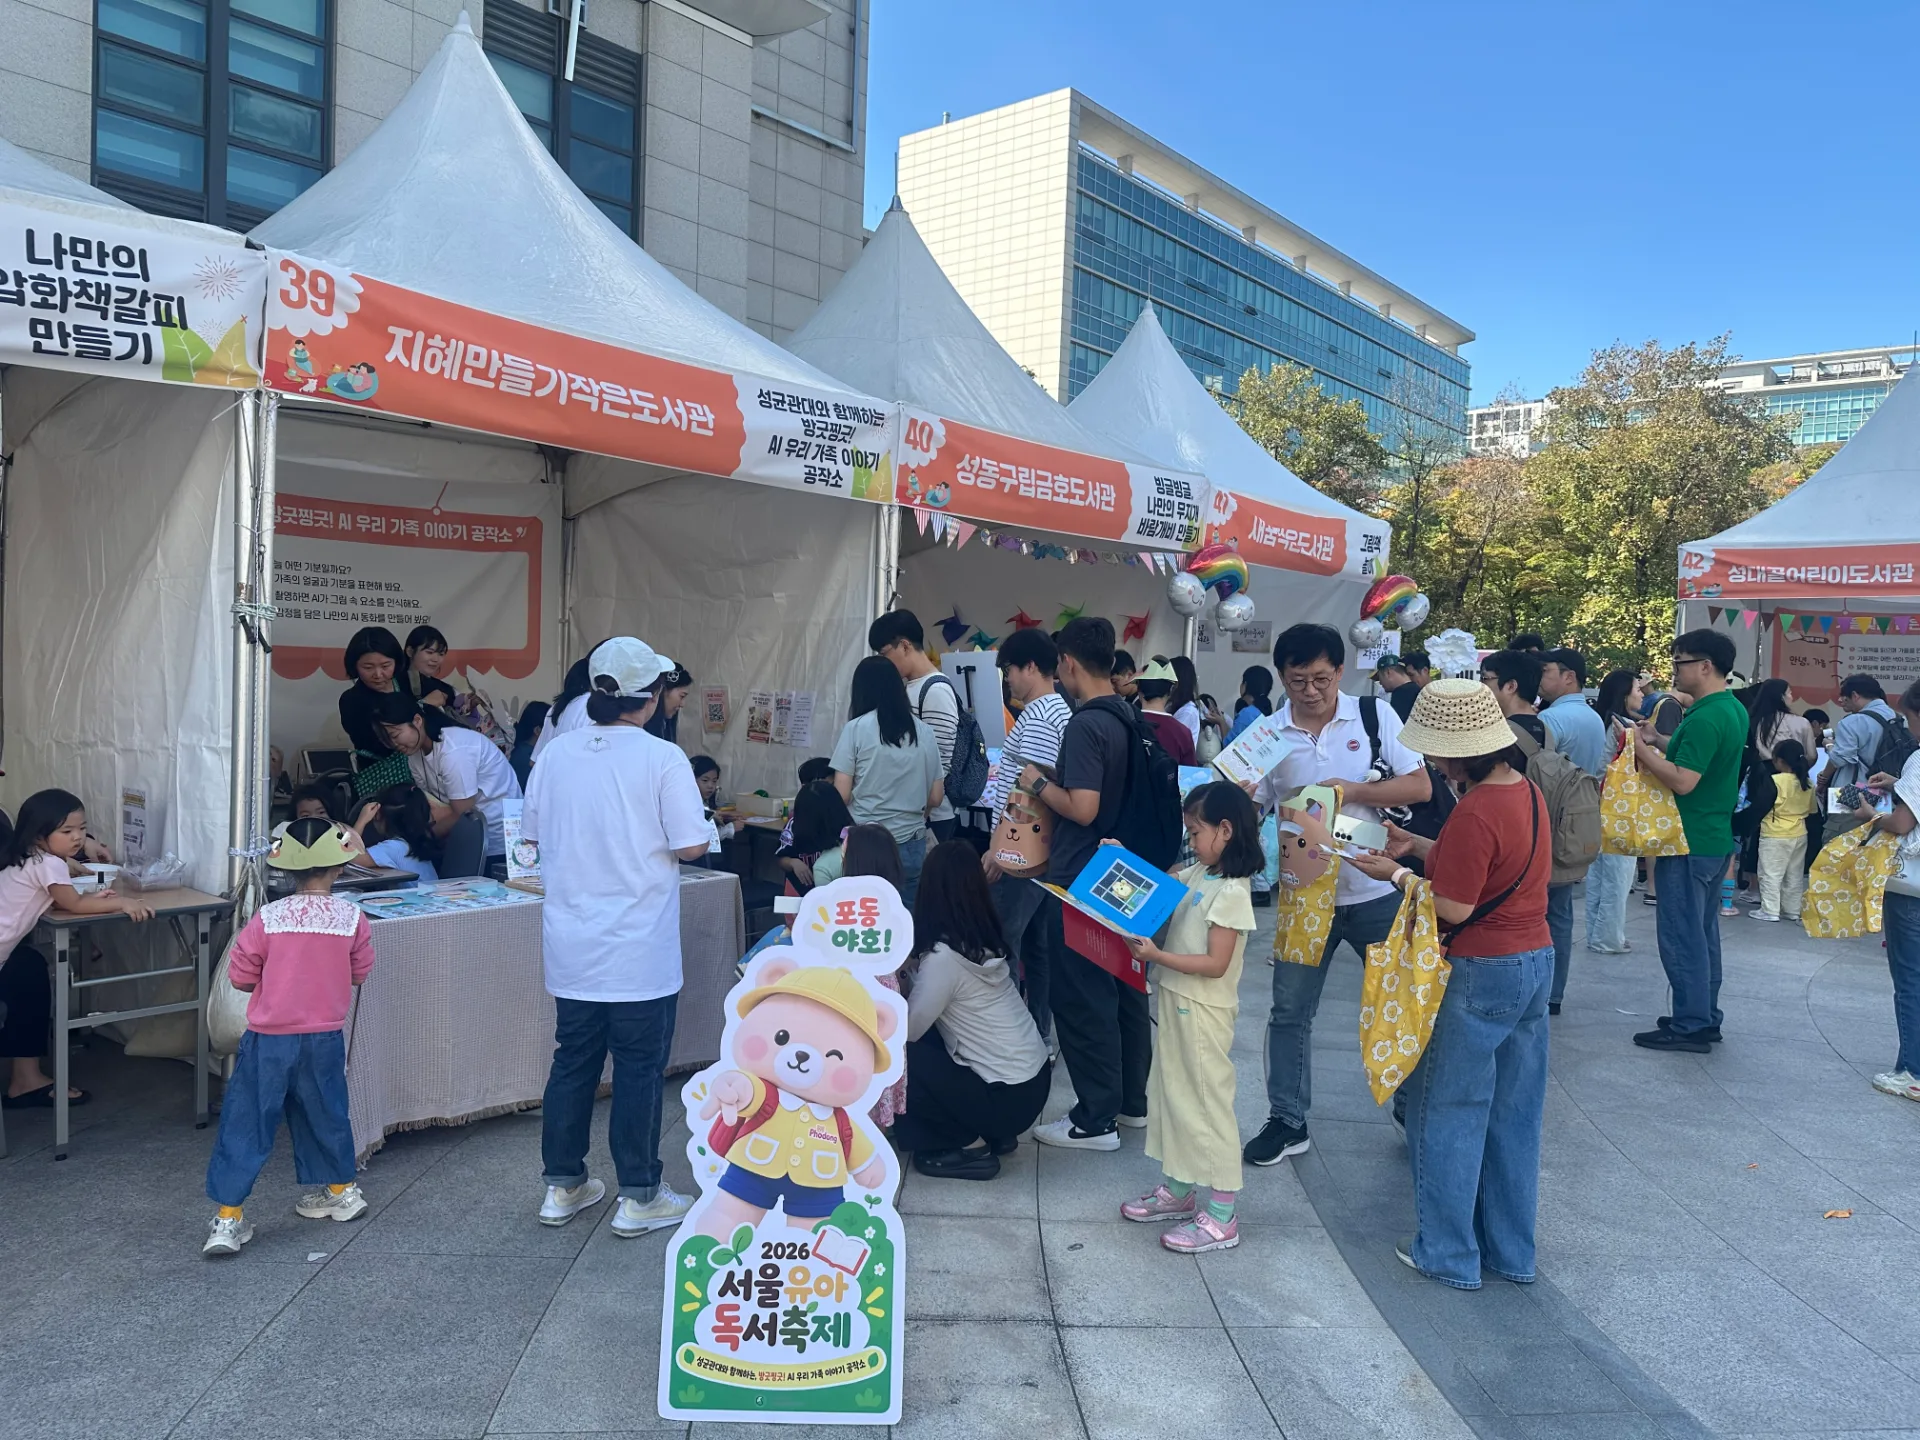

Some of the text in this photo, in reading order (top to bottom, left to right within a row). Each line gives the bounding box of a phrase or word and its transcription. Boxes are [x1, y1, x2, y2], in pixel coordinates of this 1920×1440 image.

[26, 228, 150, 282] 나만의
[0, 268, 188, 330] 압화책갈피
[279, 258, 336, 317] 39
[29, 317, 153, 365] 만들기
[385, 325, 715, 436] 지혜만들기작은도서관
[757, 388, 831, 418] 성균관대와
[801, 418, 857, 444] 방긋찡긋!
[904, 418, 934, 453] 40
[767, 435, 880, 472] AI 우리 가족 이야기
[803, 464, 844, 488] 공작소
[956, 454, 1116, 512] 성동구립금호도서관
[1147, 496, 1199, 523] 나만의 무지개
[338, 513, 351, 530] AI
[356, 515, 386, 534] 우리
[390, 518, 419, 537] 가족
[424, 521, 467, 540] 이야기
[471, 525, 512, 543] 공작소
[1136, 517, 1200, 544] 바람개비 만들기
[285, 561, 302, 571] 어떤
[305, 562, 351, 575] 기분일까요?
[1682, 552, 1704, 570] 42
[1727, 563, 1914, 585] 성대골어린이도서관
[274, 574, 300, 585] 가족의
[303, 576, 329, 587] 얼굴과
[331, 578, 355, 590] 기분을
[358, 581, 383, 592] 표현해
[311, 593, 329, 604] AI가
[330, 594, 347, 605] 그림
[349, 595, 358, 606] 속
[359, 597, 385, 608] 요소를
[304, 609, 321, 620] 담은
[323, 610, 349, 621] 나만의
[351, 613, 359, 622] AI
[361, 613, 386, 624] 동화를
[388, 613, 412, 624] 만들어
[834, 897, 880, 927] 포동
[831, 928, 892, 954] 야호!
[809, 1128, 838, 1144] Phodong
[761, 1241, 810, 1260] 2026
[717, 1263, 849, 1308] 서울유아
[711, 1303, 852, 1354] 독서축제
[696, 1356, 729, 1374] 성균관대와
[729, 1366, 757, 1381] 함께하는,
[787, 1372, 795, 1381] AI
[796, 1370, 809, 1382] 우리
[810, 1369, 824, 1380] 가족
[825, 1365, 846, 1378] 이야기
[846, 1359, 866, 1373] 공작소
